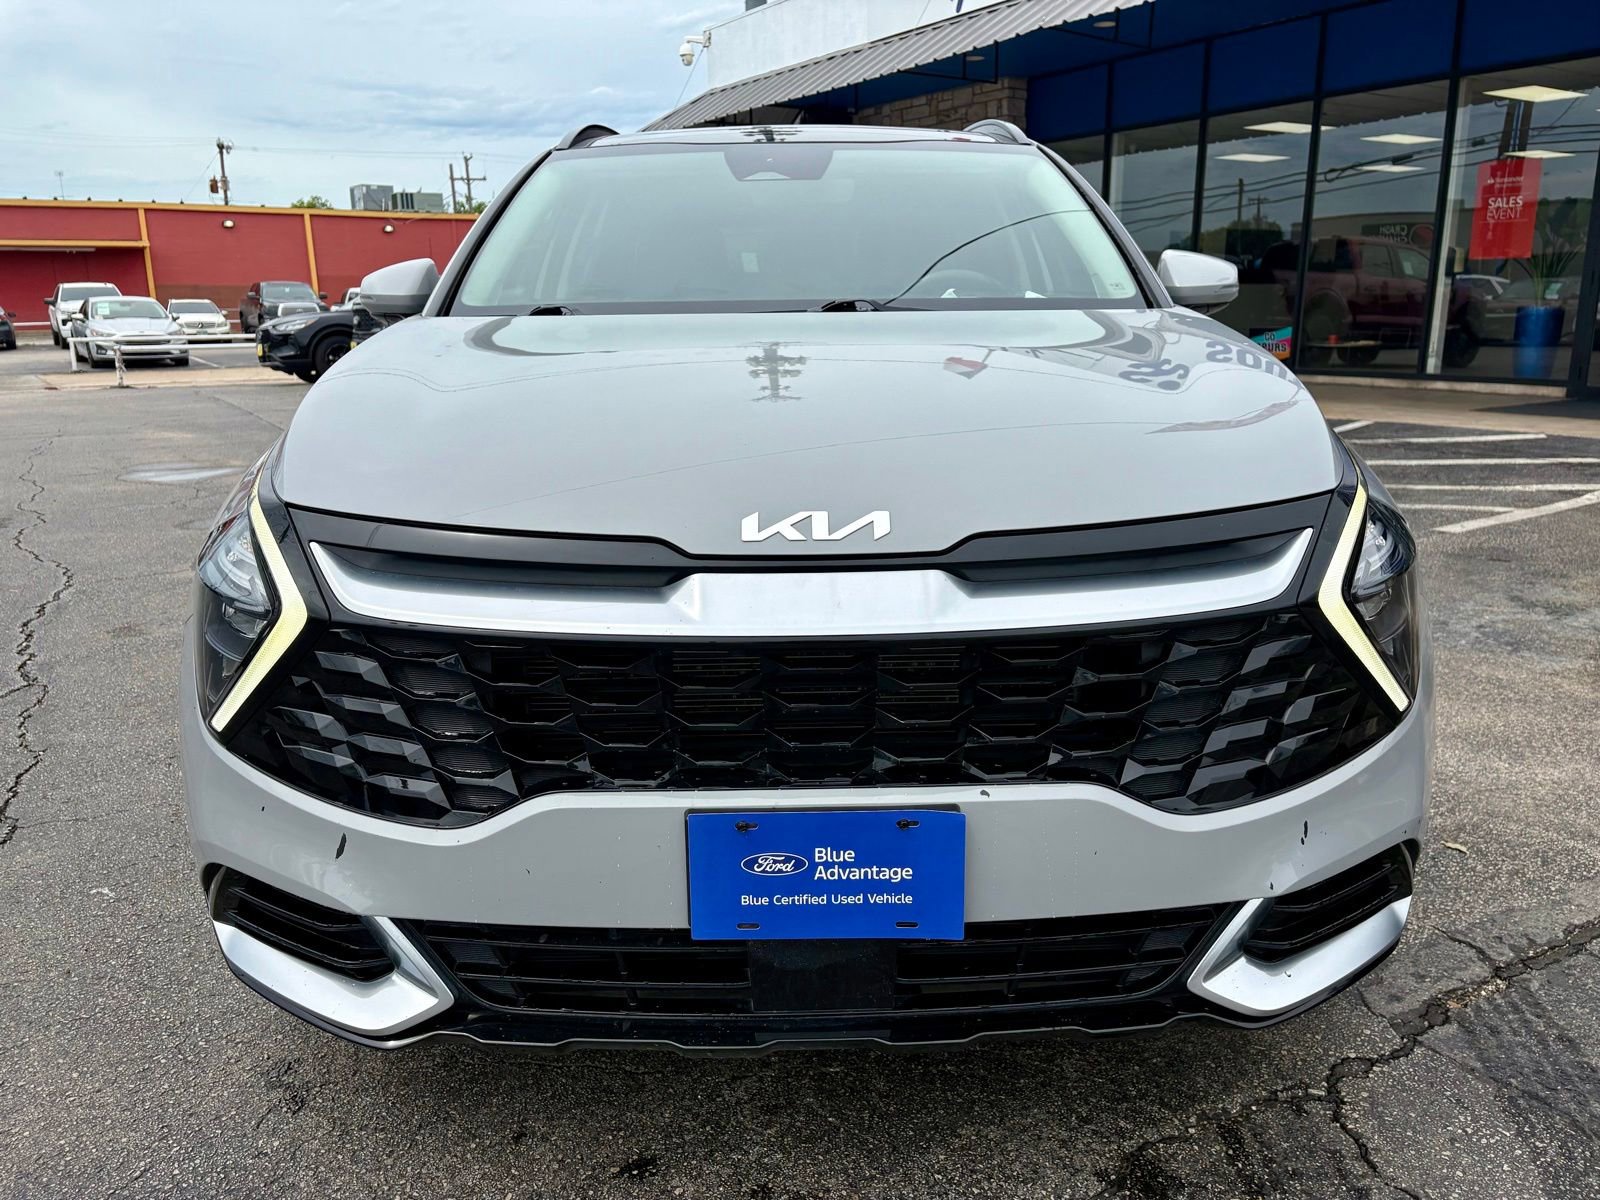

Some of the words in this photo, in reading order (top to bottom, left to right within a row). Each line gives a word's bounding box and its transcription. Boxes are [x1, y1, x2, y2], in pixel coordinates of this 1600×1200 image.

[1488, 195, 1523, 208] SALES
[1486, 206, 1522, 220] EVENT
[741, 510, 891, 542] KIA
[814, 847, 855, 862] Blue
[814, 865, 913, 882] Advantage
[741, 894, 769, 905] Blue
[773, 894, 827, 905] Certified
[831, 893, 863, 904] Used
[868, 893, 913, 904] Vehicle
